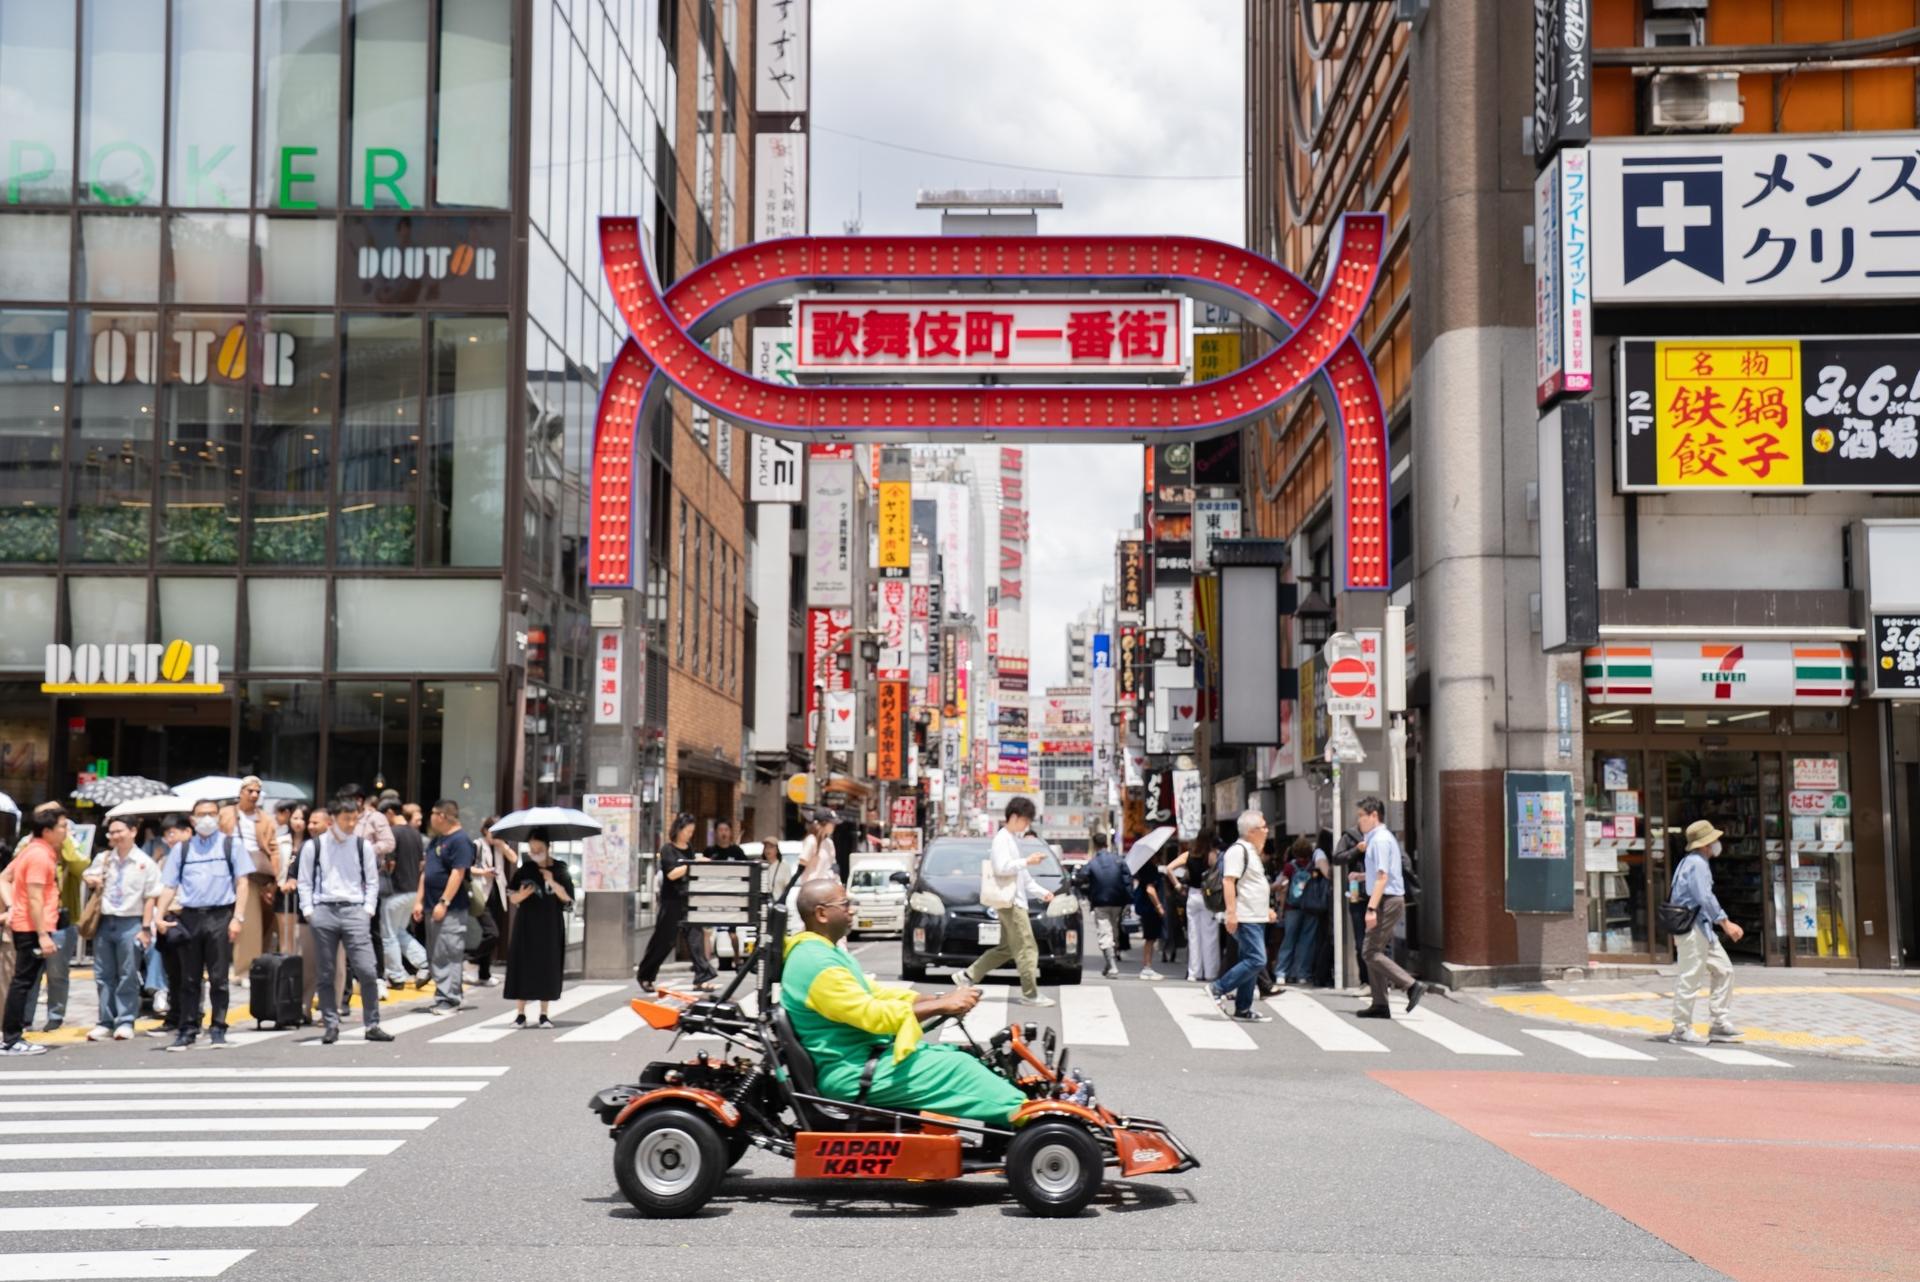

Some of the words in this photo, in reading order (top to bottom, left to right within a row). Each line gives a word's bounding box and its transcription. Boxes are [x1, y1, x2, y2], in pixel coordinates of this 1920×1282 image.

[1566, 53, 1587, 125] スパークル
[9, 140, 412, 210] POKER
[358, 244, 497, 280] DOUTOR
[811, 310, 1168, 360] 歌舞伎町一番街
[1689, 351, 1770, 378] 名物
[1668, 386, 1790, 430] 鉄鍋
[1668, 433, 1790, 480] 餃子
[1838, 415, 1919, 460] 酒場
[45, 639, 220, 684] DOUTOR
[602, 634, 617, 716] 劇場通り
[1796, 759, 1837, 769] ATM
[1791, 795, 1825, 809] たばこ
[1832, 794, 1847, 809] 酒
[815, 1140, 902, 1156] JAPAN
[823, 1159, 893, 1175] KART
